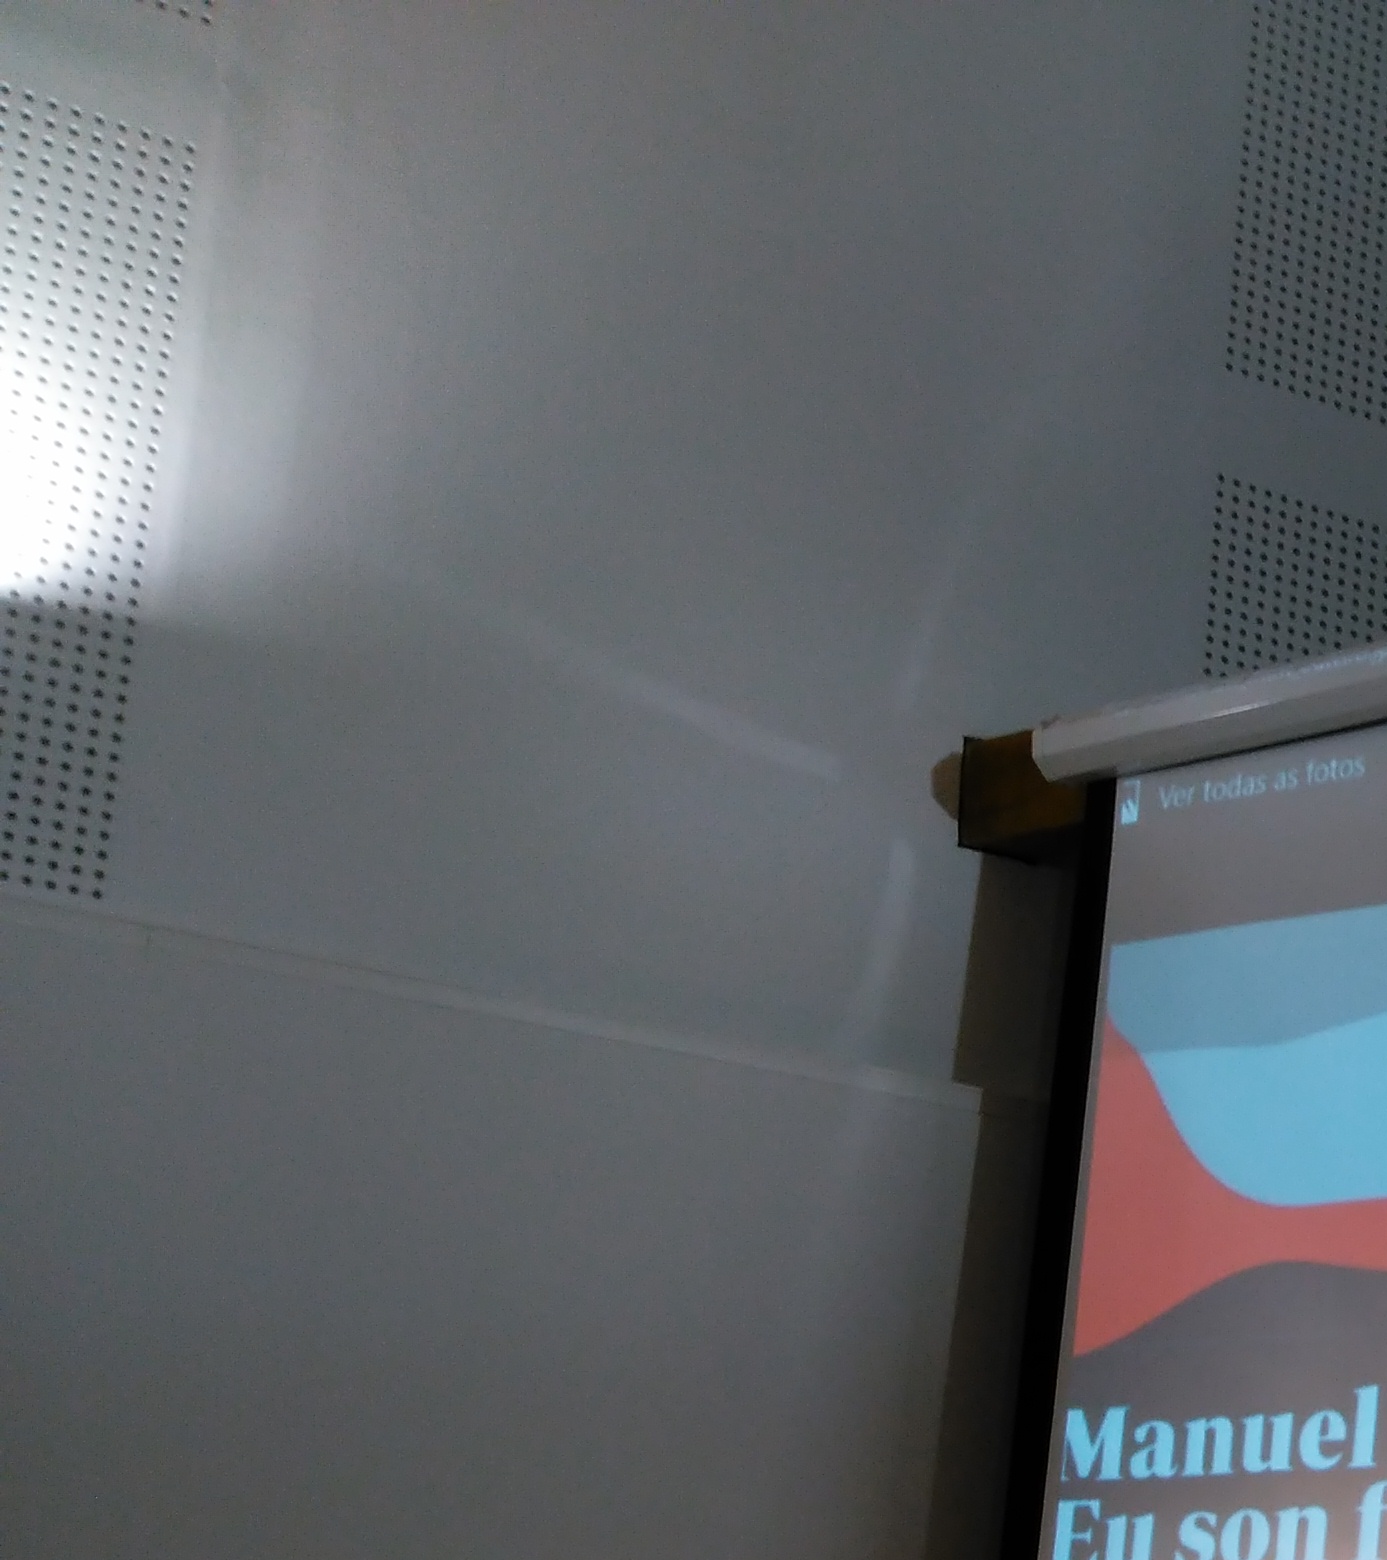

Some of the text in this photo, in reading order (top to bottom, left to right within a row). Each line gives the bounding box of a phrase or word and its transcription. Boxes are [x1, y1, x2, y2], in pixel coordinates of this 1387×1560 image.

[1158, 756, 1366, 809] Ver todas as fotos
[1061, 1384, 1379, 1481] Manuel
